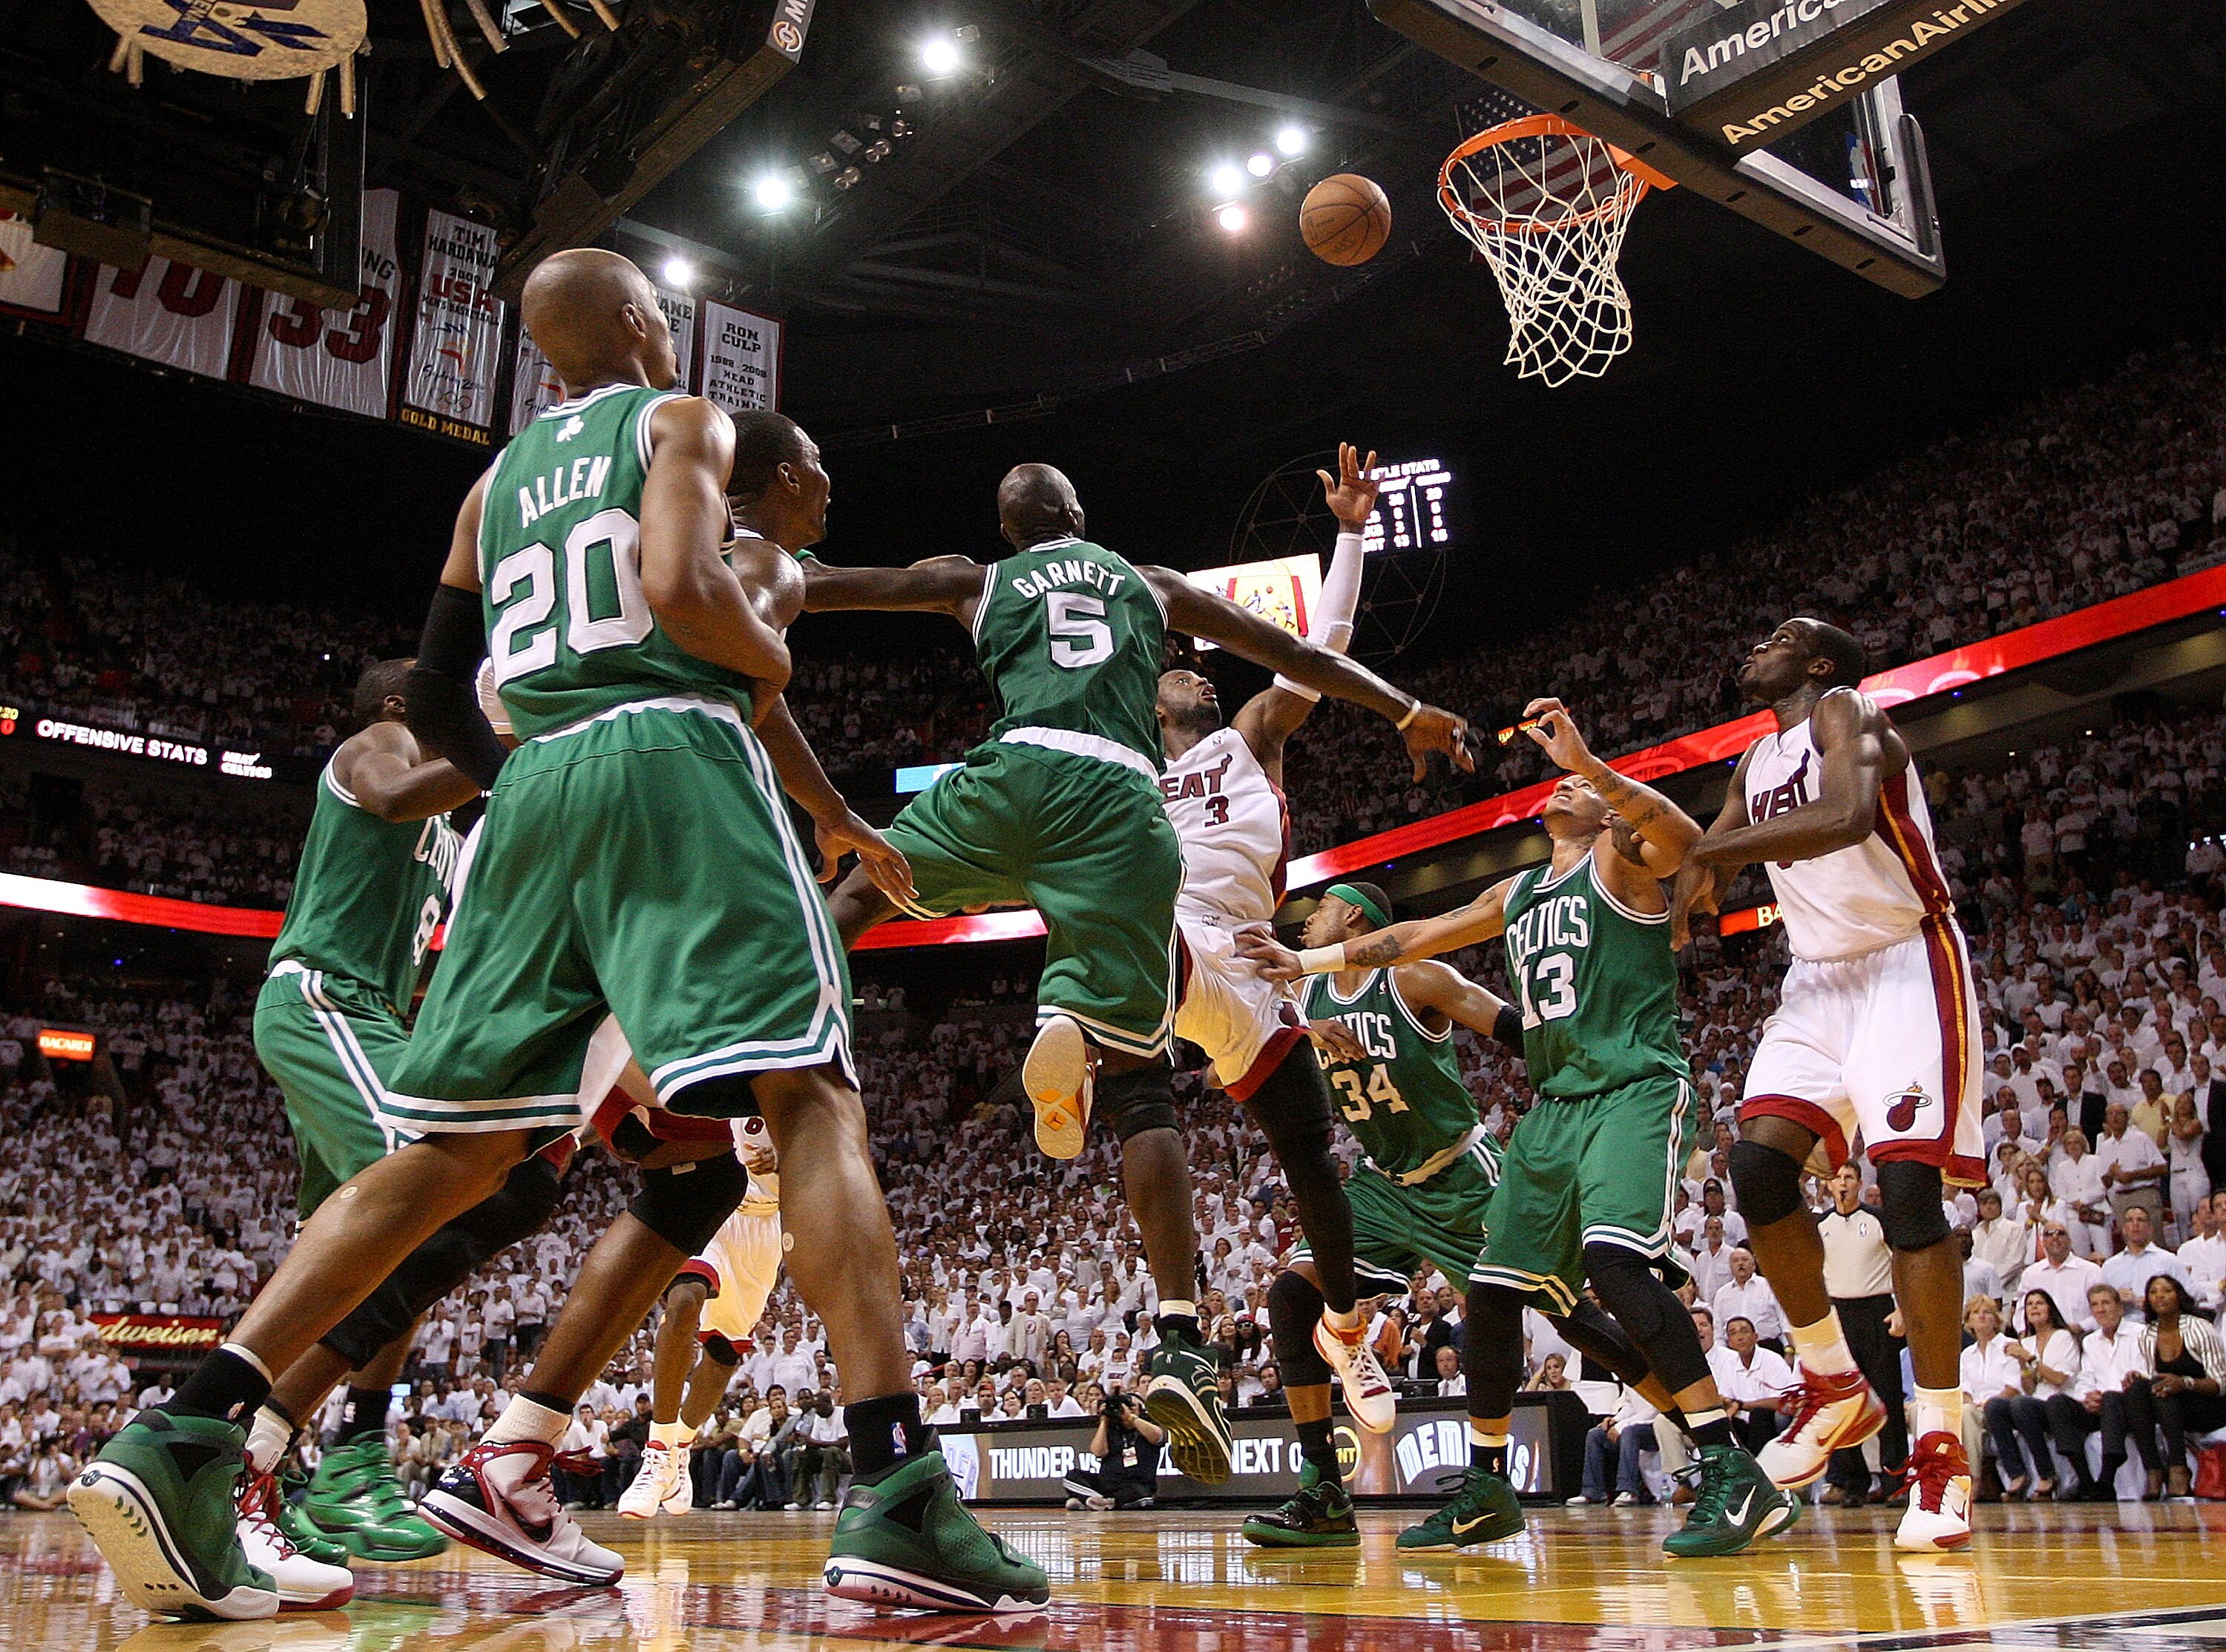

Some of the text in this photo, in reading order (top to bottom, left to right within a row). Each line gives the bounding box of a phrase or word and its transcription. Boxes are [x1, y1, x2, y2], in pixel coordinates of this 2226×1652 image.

[1680, 0, 1845, 86] Americ
[428, 234, 496, 269] HARDAWA
[455, 226, 486, 249] TIM
[431, 274, 493, 312] USA
[450, 267, 480, 283] 2000
[268, 284, 392, 363] 33
[726, 322, 759, 341] RON
[721, 333, 762, 352] CULP
[709, 379, 766, 403] ATHLETIC
[723, 370, 755, 386] HEAD
[401, 408, 490, 445] GOLD MEDAL
[519, 455, 612, 529] ALLEN
[1011, 560, 1126, 599] GARNETT
[490, 507, 654, 690] 20
[1046, 590, 1114, 668] 5
[37, 719, 208, 766] OFFENSIVE STATS
[1159, 752, 1233, 804] EAT
[1204, 795, 1229, 827] 3
[1505, 895, 1590, 978] CELTICS
[1521, 952, 1577, 1031] 13
[39, 1036, 93, 1052] BACARDI
[1331, 1063, 1410, 1122] 34
[988, 1446, 1074, 1479] THUNDER
[1289, 1444, 1304, 1474] O
